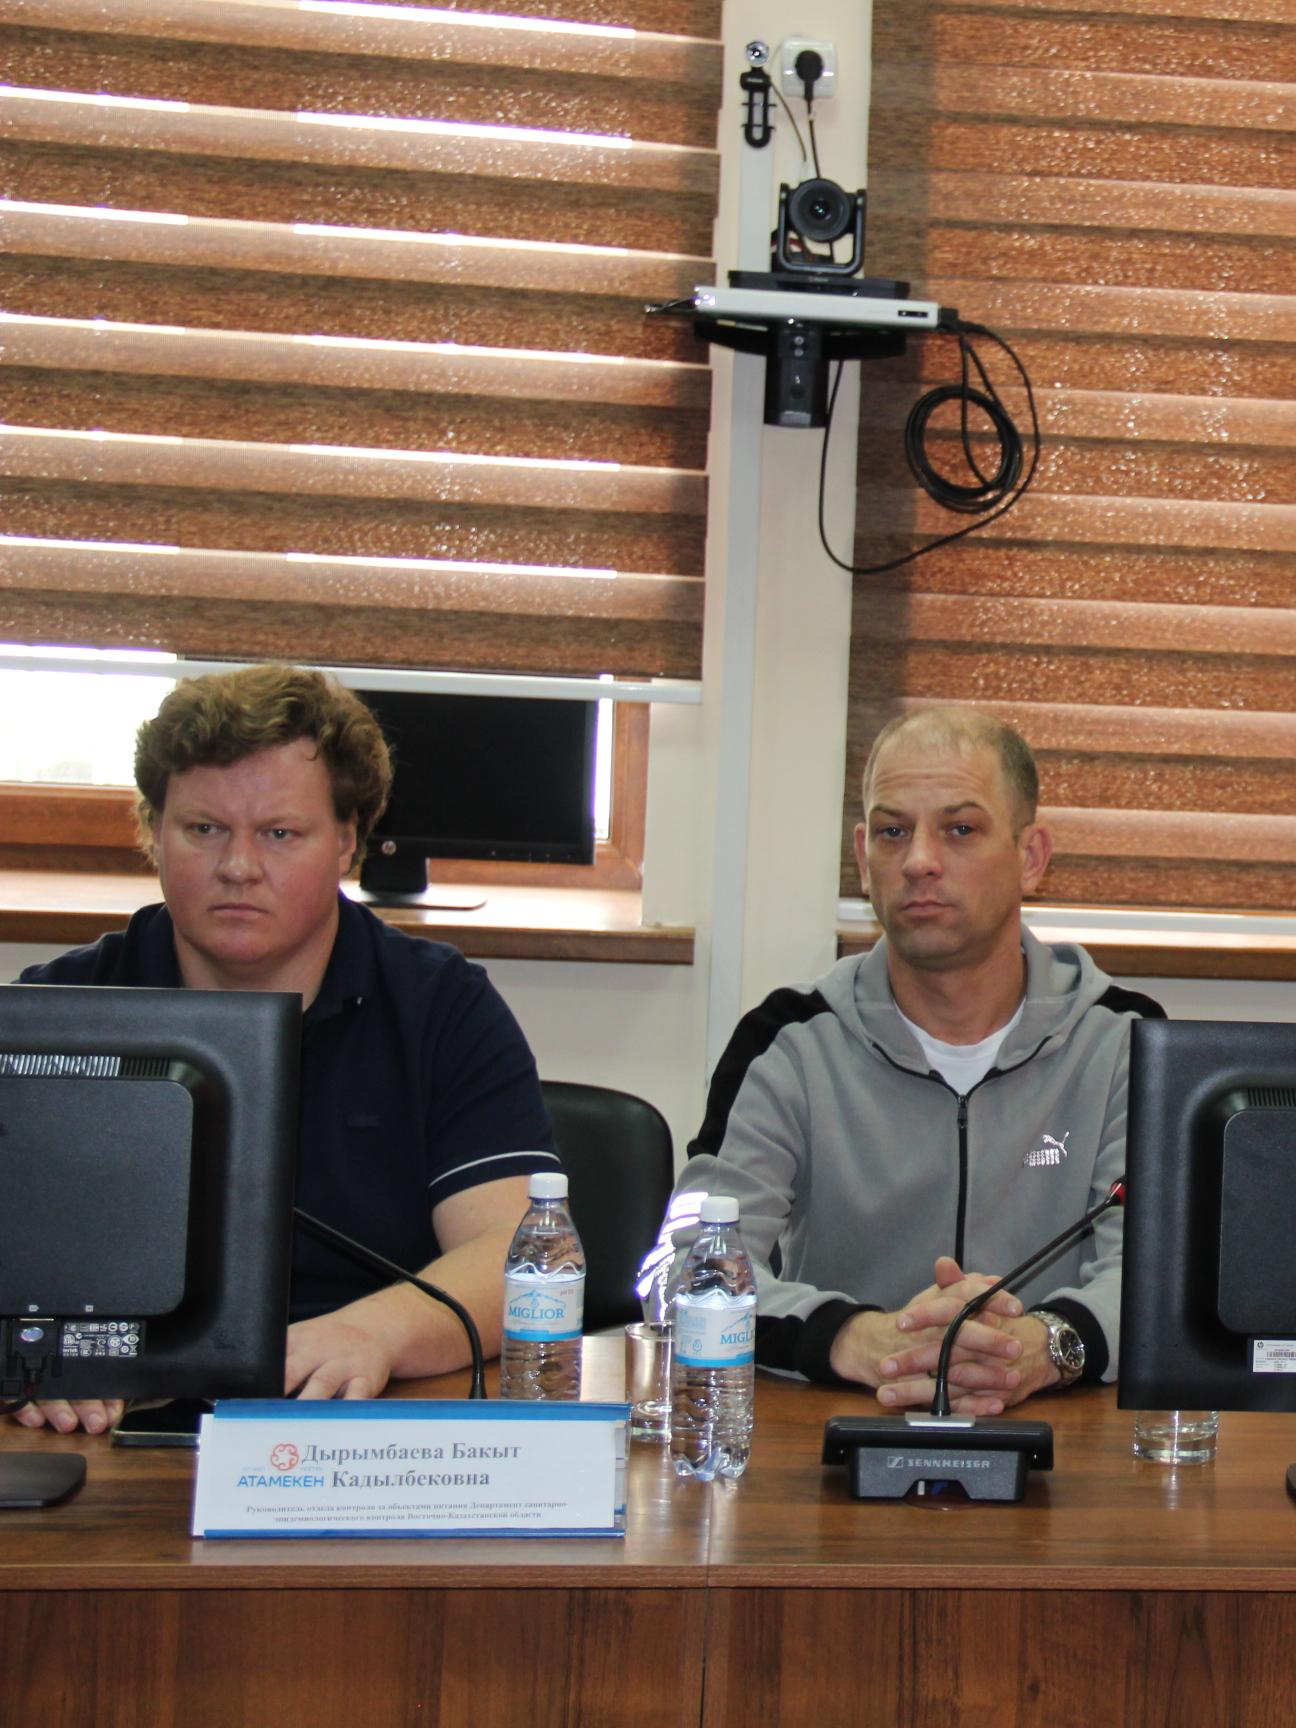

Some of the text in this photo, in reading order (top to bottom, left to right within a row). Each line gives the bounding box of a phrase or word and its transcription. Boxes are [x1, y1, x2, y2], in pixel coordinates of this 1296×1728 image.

[508, 1305, 565, 1320] MIGLIOR
[302, 1442, 521, 1465] Дырымбаева Бакыт
[907, 1457, 991, 1468] SENNHEISER
[237, 1475, 325, 1488] АТАМЕКЕН
[333, 1469, 490, 1488] Кадылбековна
